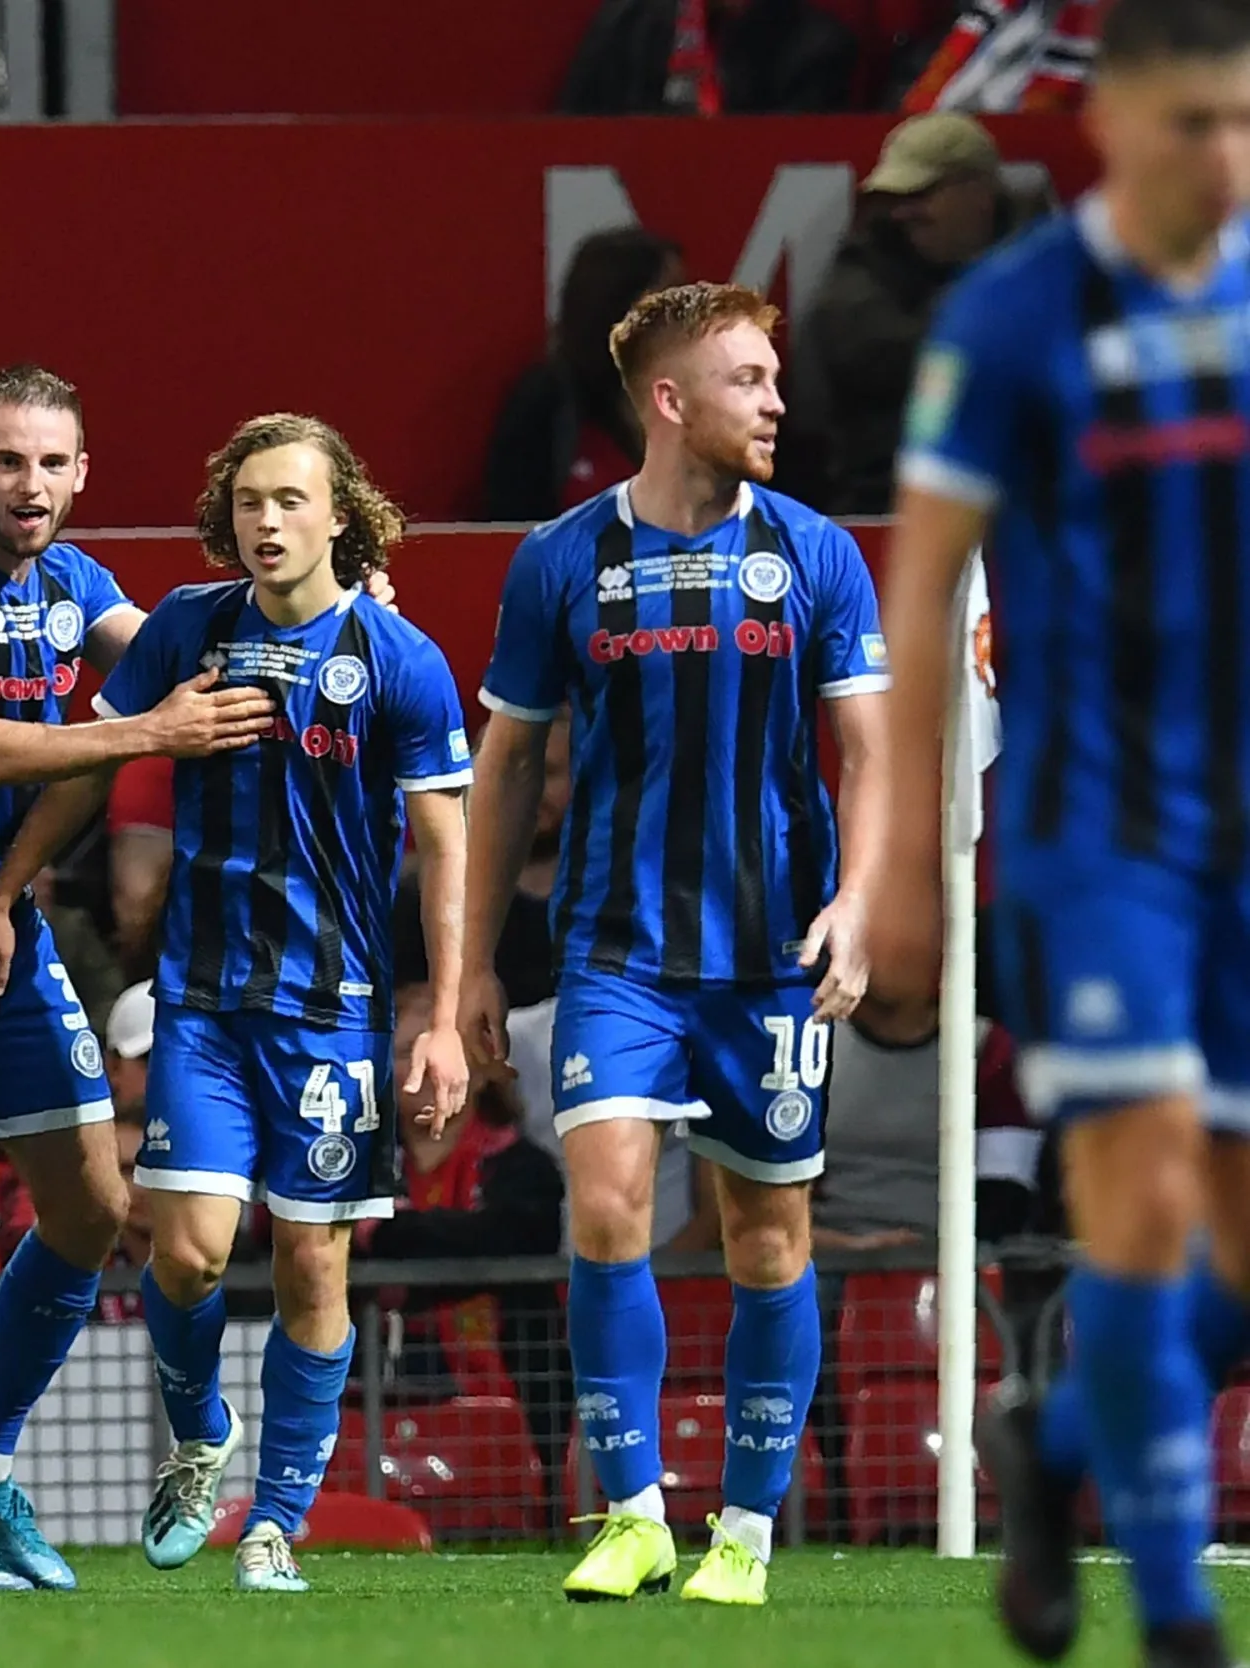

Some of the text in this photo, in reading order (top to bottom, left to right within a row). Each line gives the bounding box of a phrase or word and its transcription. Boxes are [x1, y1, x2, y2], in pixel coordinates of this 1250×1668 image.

[588, 618, 795, 664] Crown Oil
[301, 723, 359, 768] Oil
[760, 1014, 830, 1090] 10
[299, 1059, 381, 1134] 41
